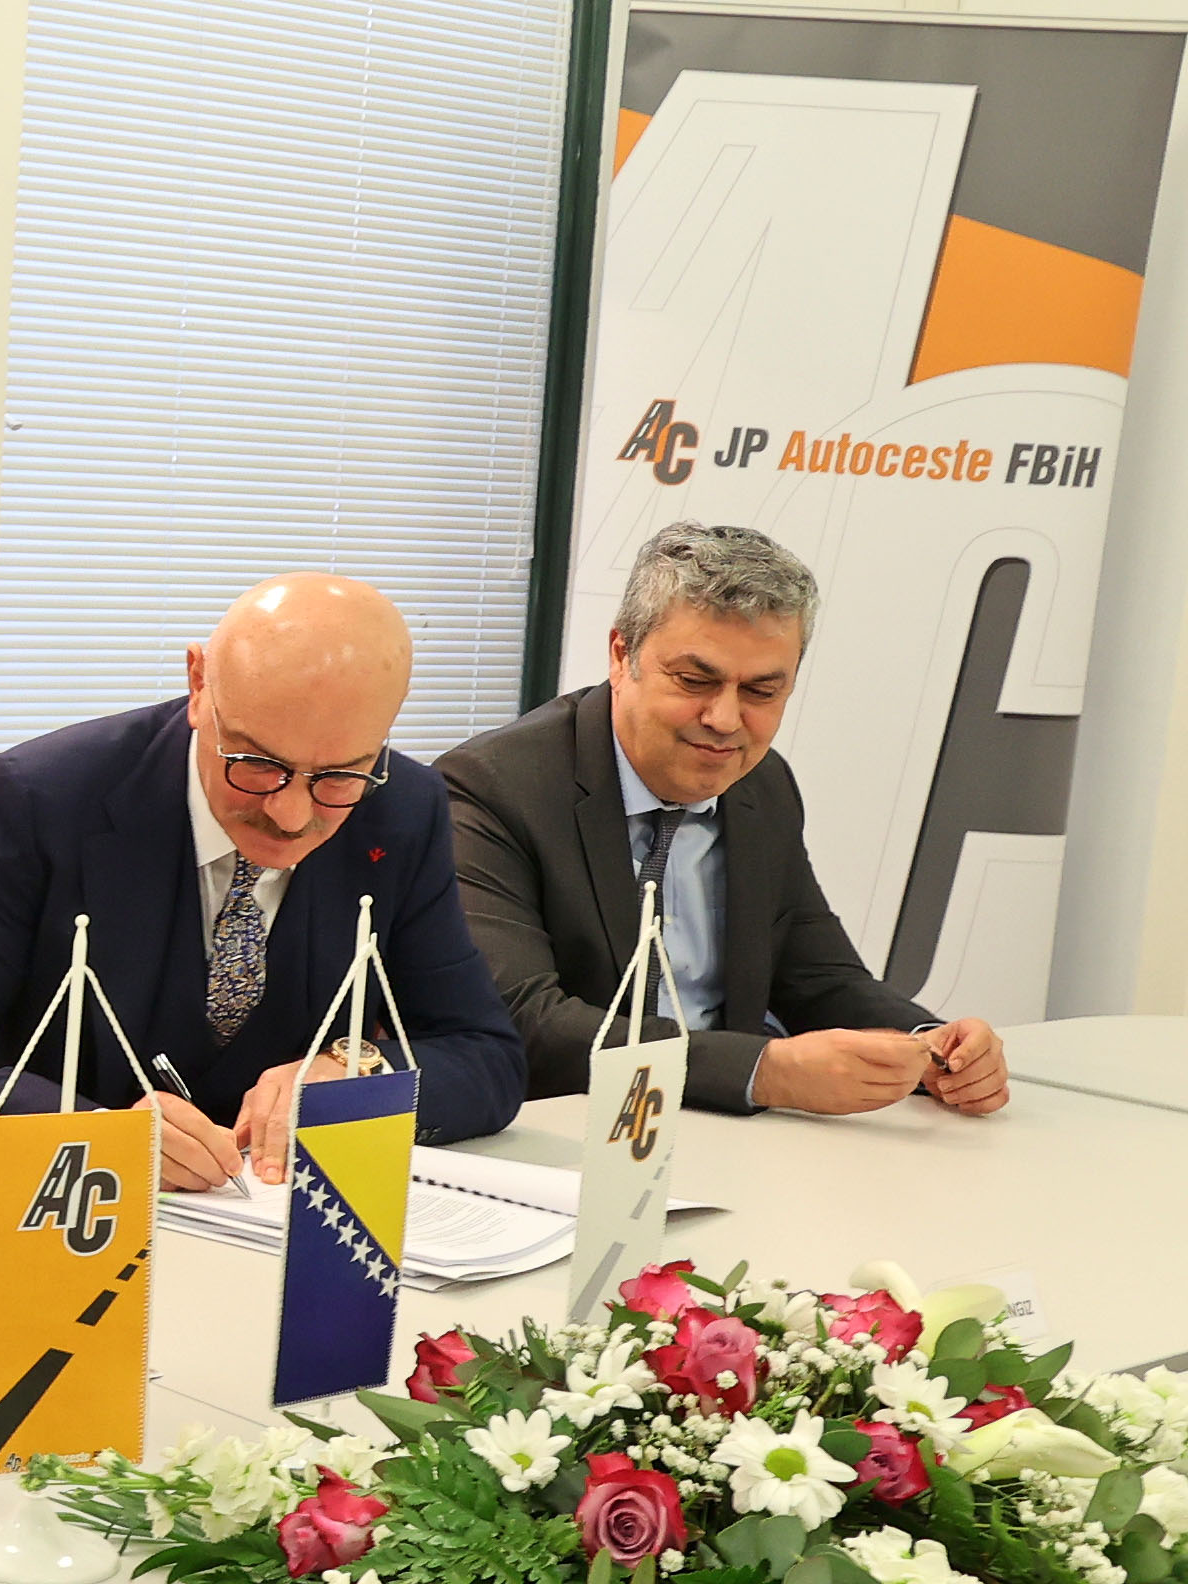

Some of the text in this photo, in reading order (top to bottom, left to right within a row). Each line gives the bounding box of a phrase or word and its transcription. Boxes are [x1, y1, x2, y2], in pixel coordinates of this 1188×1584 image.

[615, 398, 1103, 488] AC JP Autoceste FBiH
[607, 1065, 663, 1162] AC
[16, 1141, 123, 1257] AC
